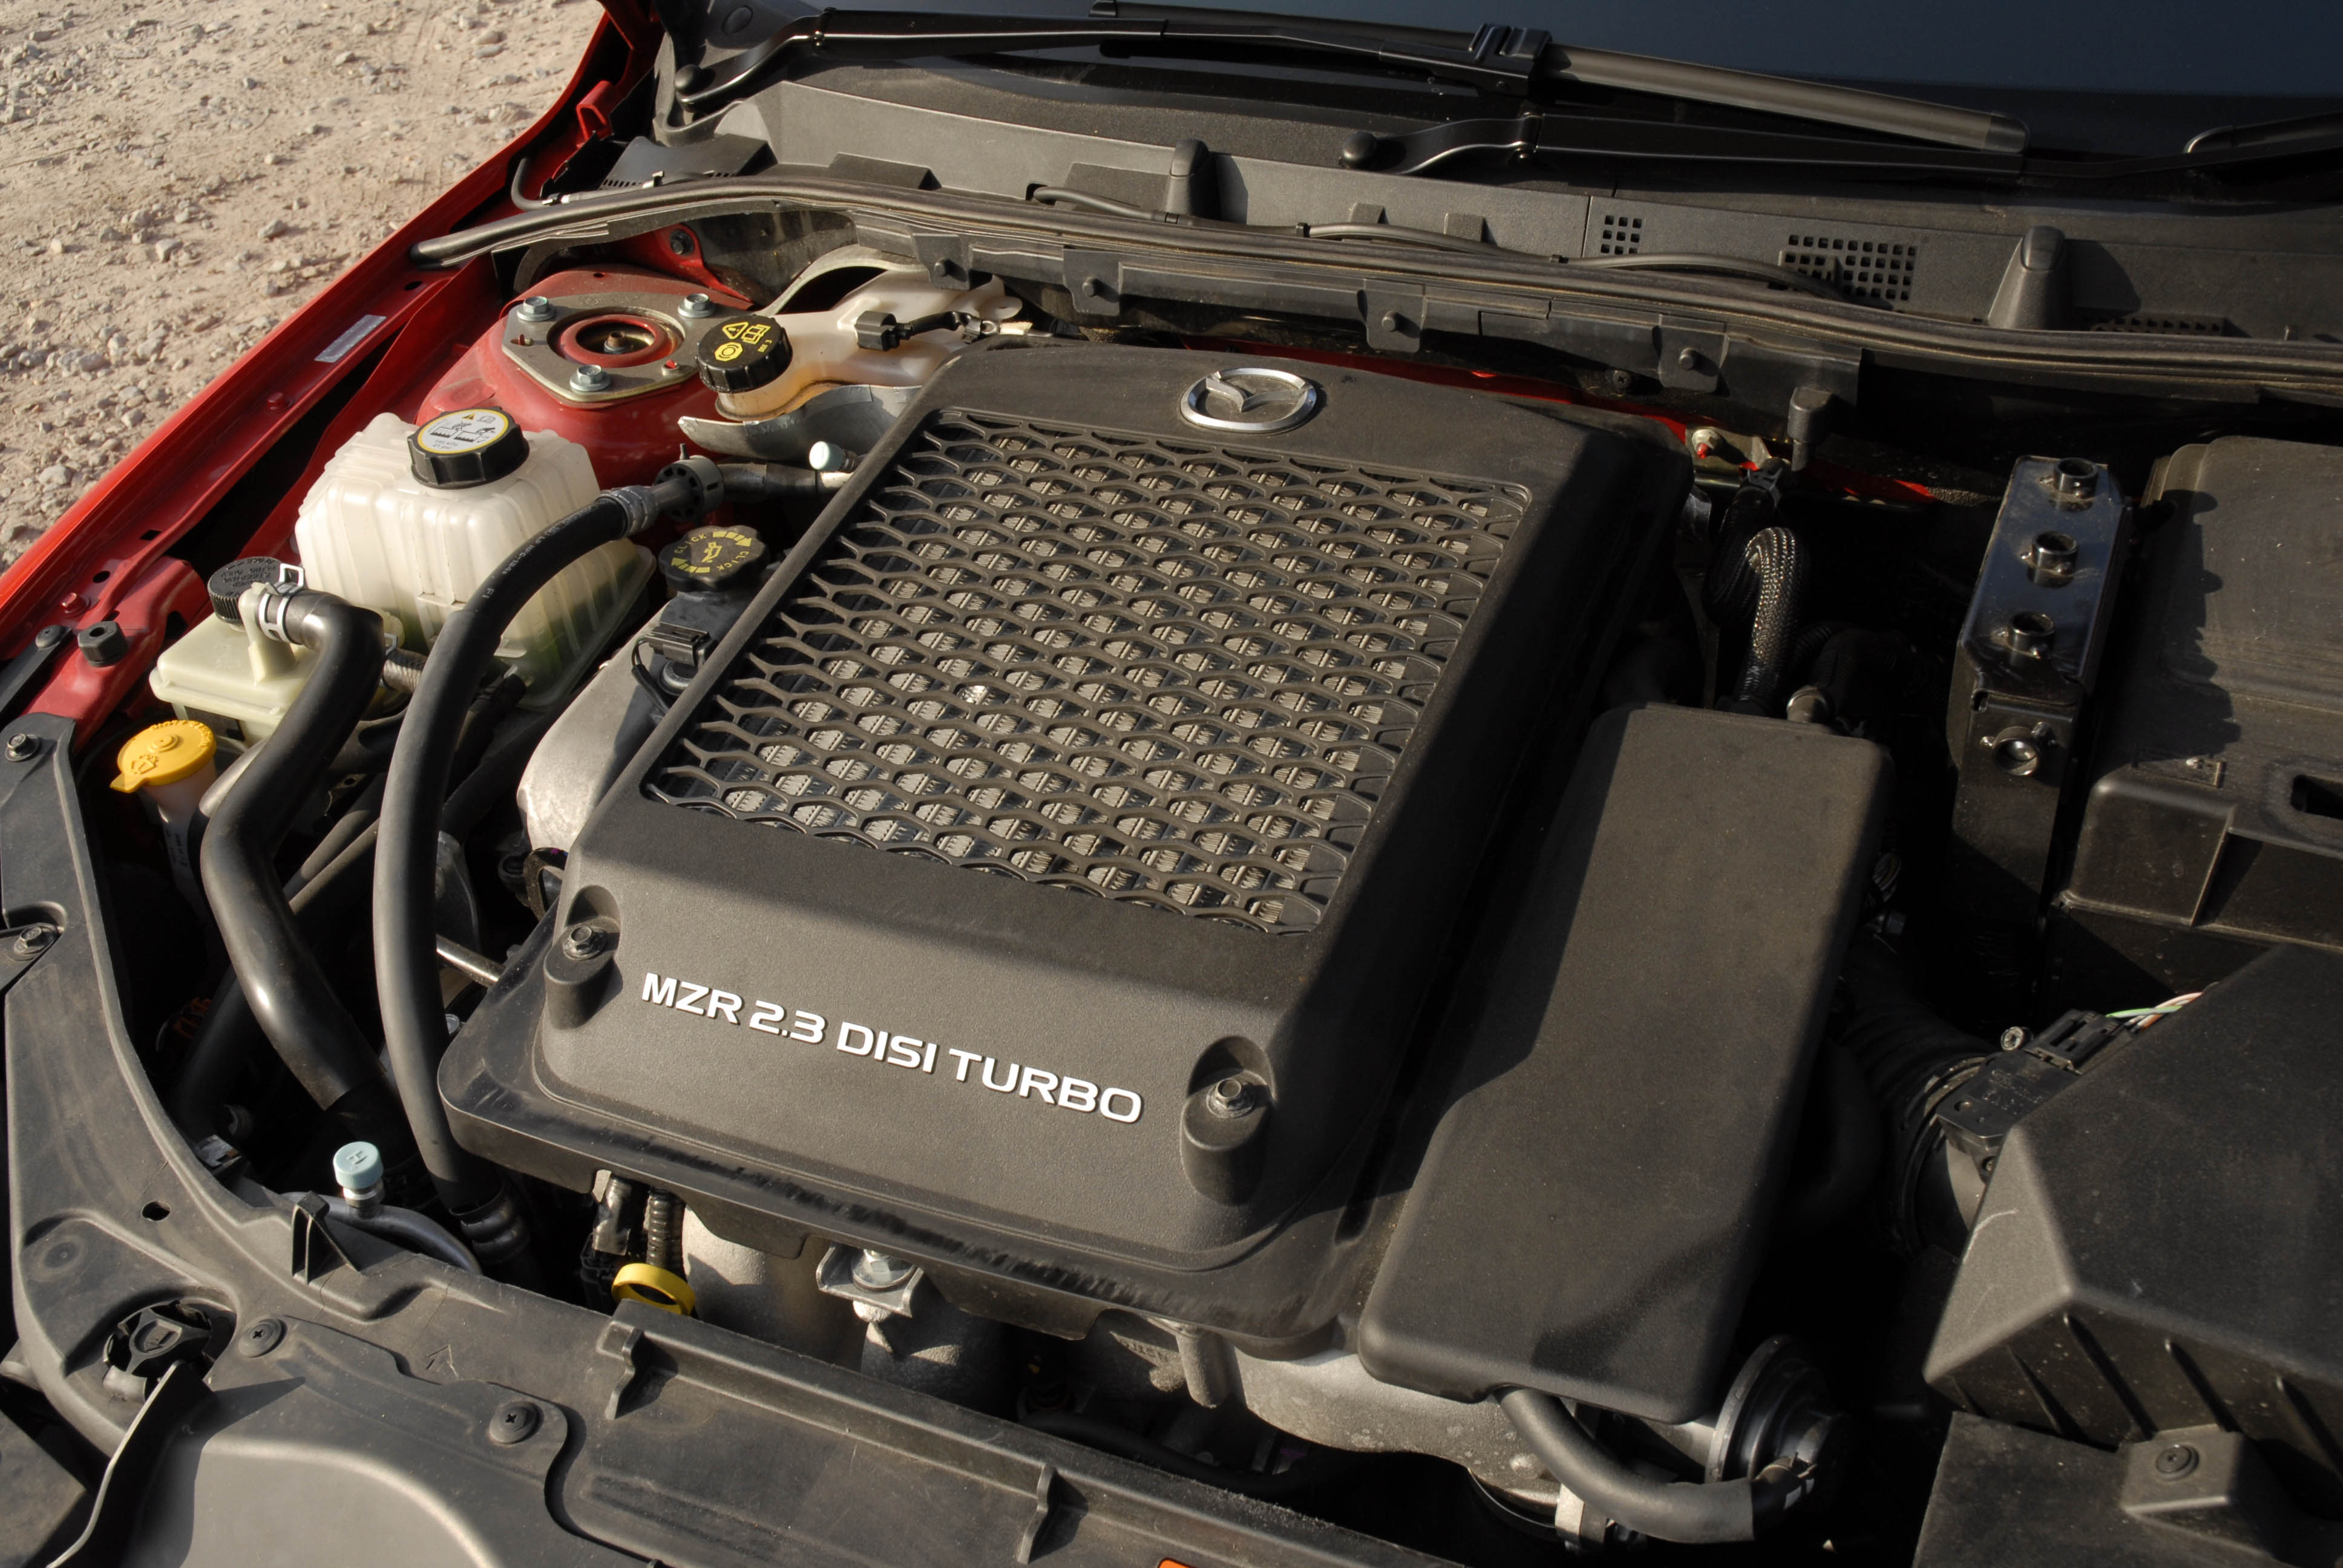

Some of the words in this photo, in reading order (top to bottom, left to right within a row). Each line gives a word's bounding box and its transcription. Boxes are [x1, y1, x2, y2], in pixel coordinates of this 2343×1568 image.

[673, 533, 707, 554] CLICK
[716, 550, 750, 571] CLICK
[641, 972, 743, 1024] MZR
[749, 999, 826, 1045] 2.3
[837, 1021, 939, 1073] DISI
[948, 1048, 1143, 1124] TURBO
[346, 1150, 368, 1165] H
